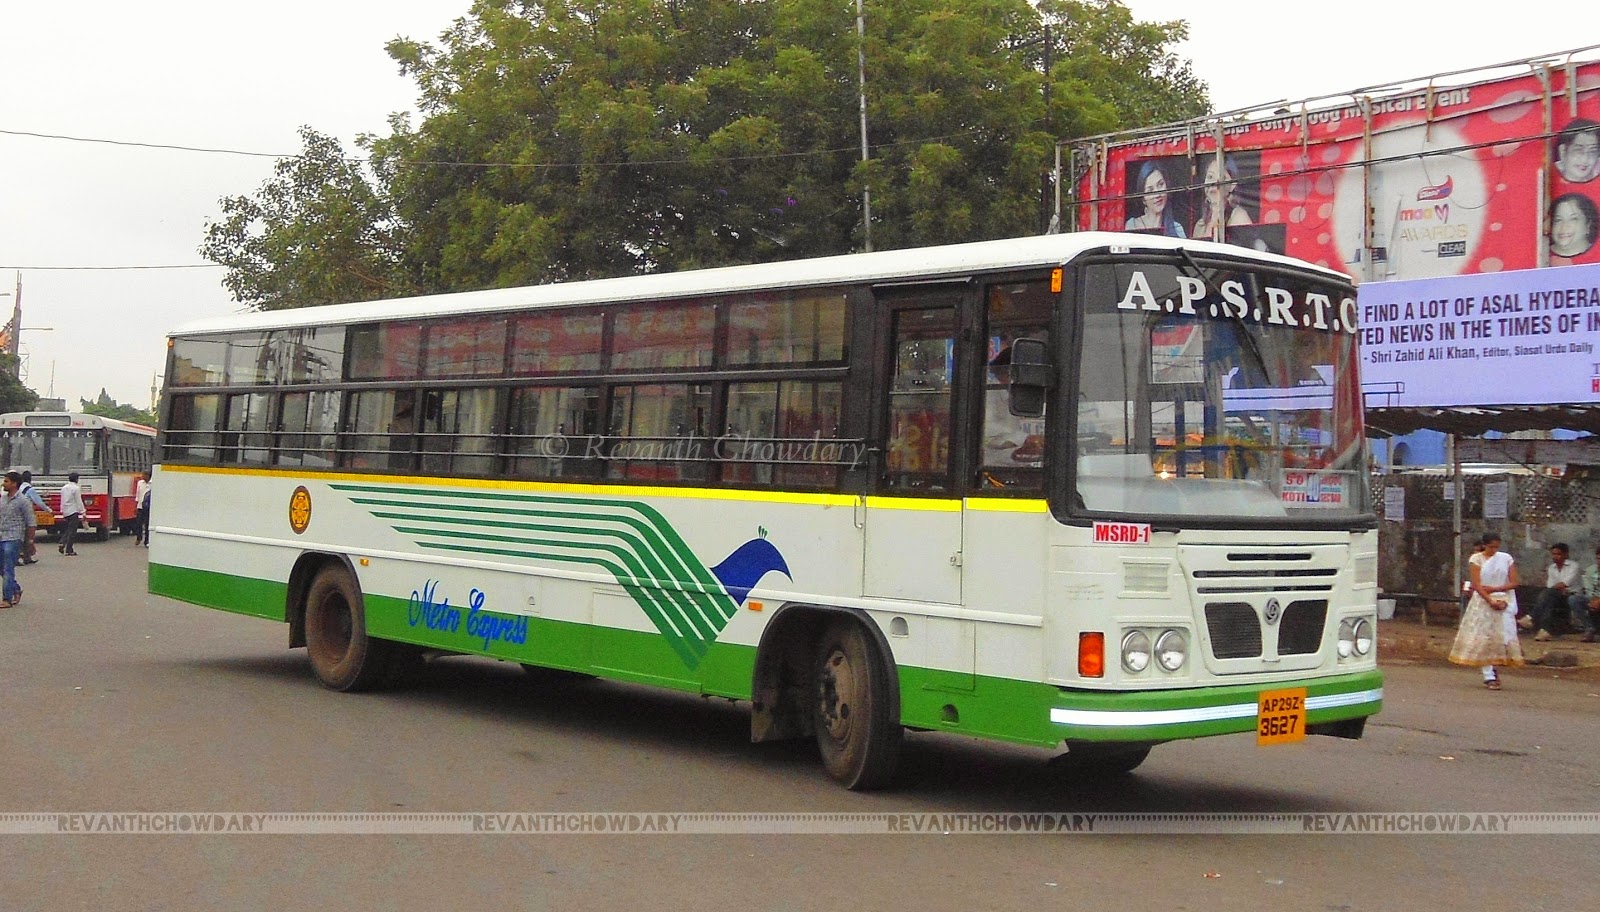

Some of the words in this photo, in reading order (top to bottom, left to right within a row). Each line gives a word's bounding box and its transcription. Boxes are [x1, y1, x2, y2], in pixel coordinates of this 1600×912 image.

[1440, 243, 1465, 254] CLEAR
[1365, 303, 1398, 323] FIND
[1404, 303, 1415, 320] A
[1420, 299, 1448, 319] LOT
[1454, 297, 1475, 316] OF
[1480, 293, 1522, 315] ASAL
[1390, 323, 1433, 343] NEWS
[1439, 321, 1455, 340] IN
[1461, 318, 1492, 338] THE
[1498, 316, 1551, 337] TIMES
[1558, 313, 1580, 333] OF
[1371, 350, 1392, 364] Shri
[1395, 348, 1425, 362] Zahid
[1428, 346, 1443, 360] Ali
[1447, 345, 1480, 360] Khan,
[1483, 346, 1512, 358] Editor,
[1515, 344, 1543, 356] Siasat
[1546, 343, 1567, 354] Urdu
[1570, 342, 1593, 356] Daily
[1282, 492, 1305, 502] KOTI
[1096, 525, 1149, 543] MSRD-1
[408, 579, 461, 633] Metro
[467, 588, 528, 652] Express
[1260, 714, 1299, 737] 3627
